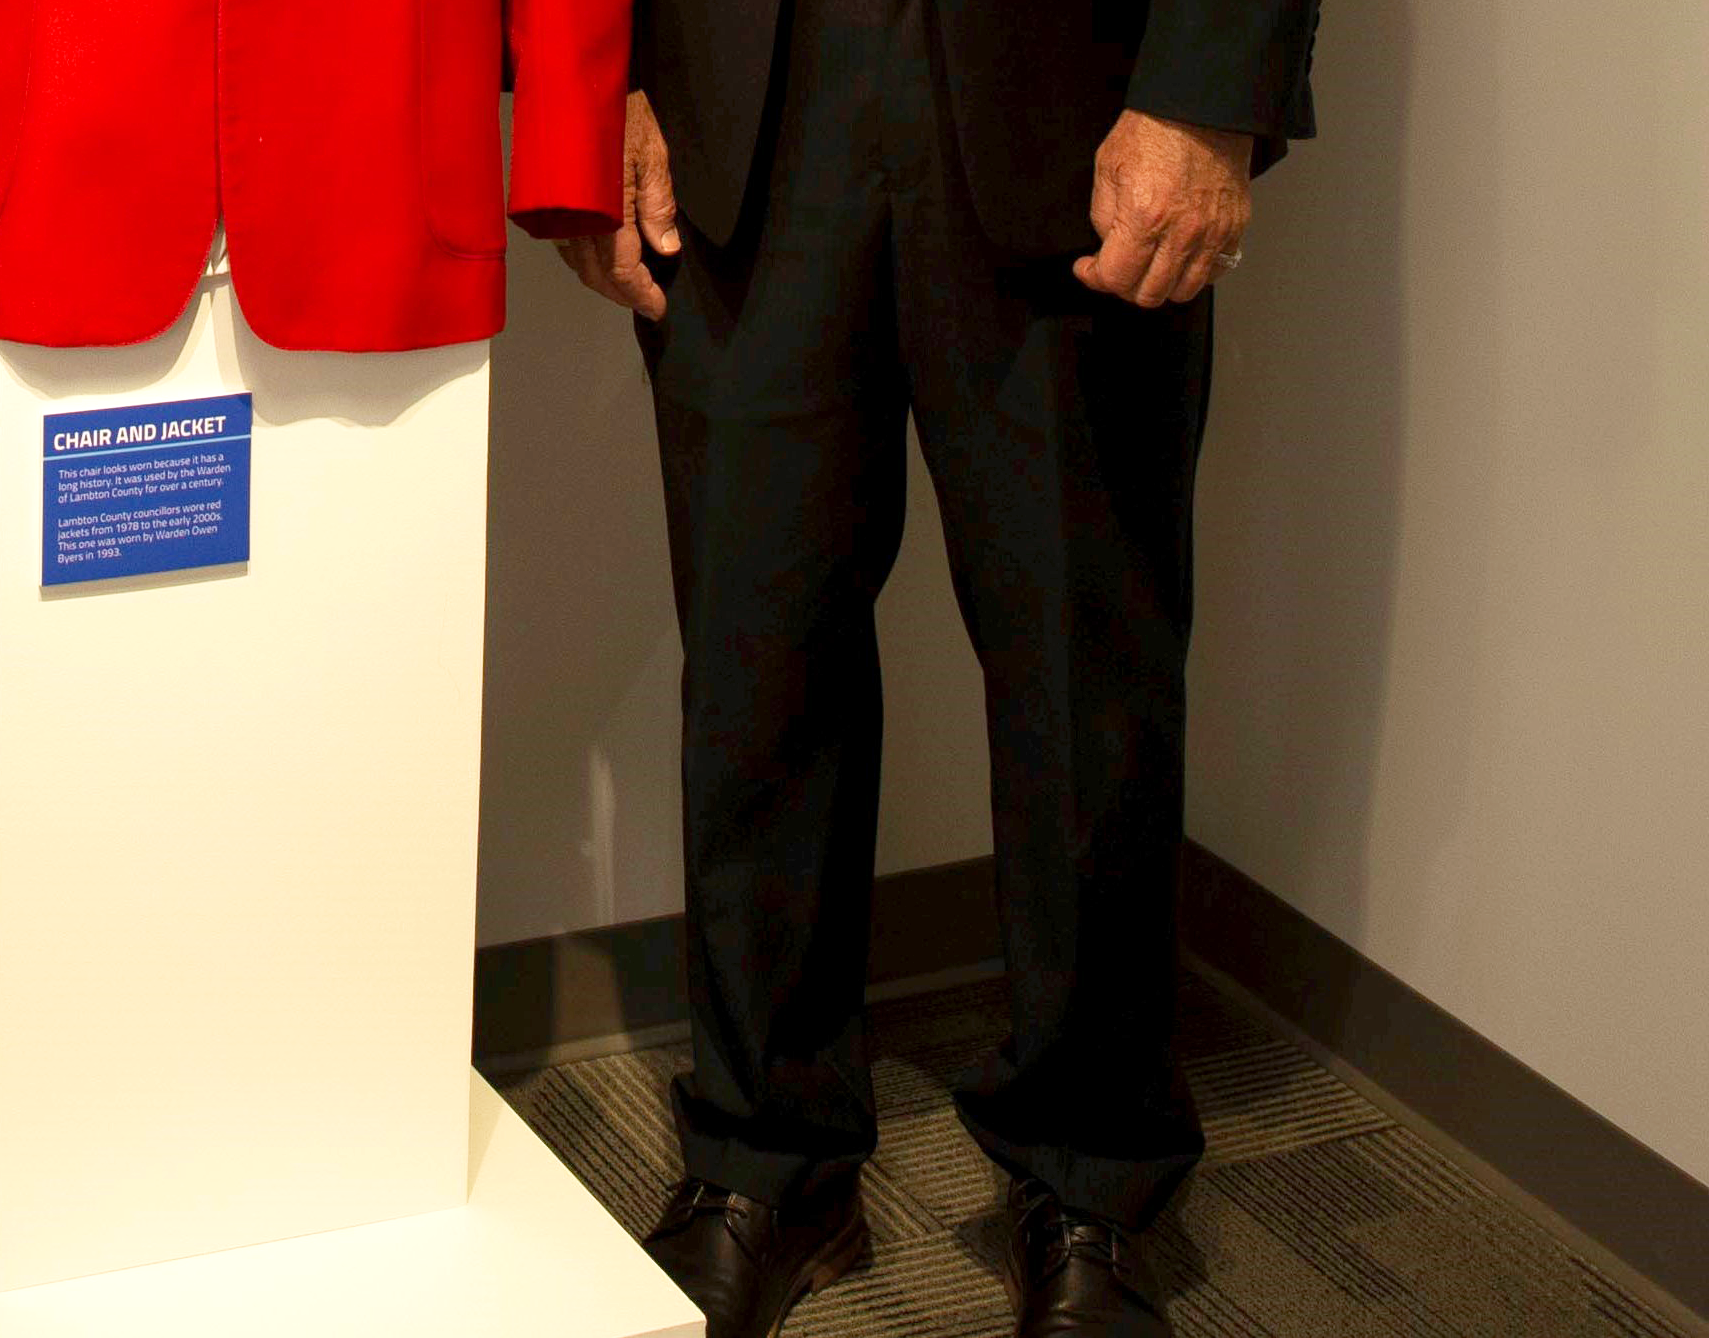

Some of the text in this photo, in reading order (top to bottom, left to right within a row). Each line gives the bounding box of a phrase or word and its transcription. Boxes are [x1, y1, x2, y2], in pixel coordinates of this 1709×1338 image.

[54, 416, 227, 451] CHAIR AND JACKET
[58, 464, 231, 494] long history. It was used by the Warden
[59, 454, 225, 479] This chair looks worn because it has a
[58, 477, 224, 504] of Lambton County for over a century.
